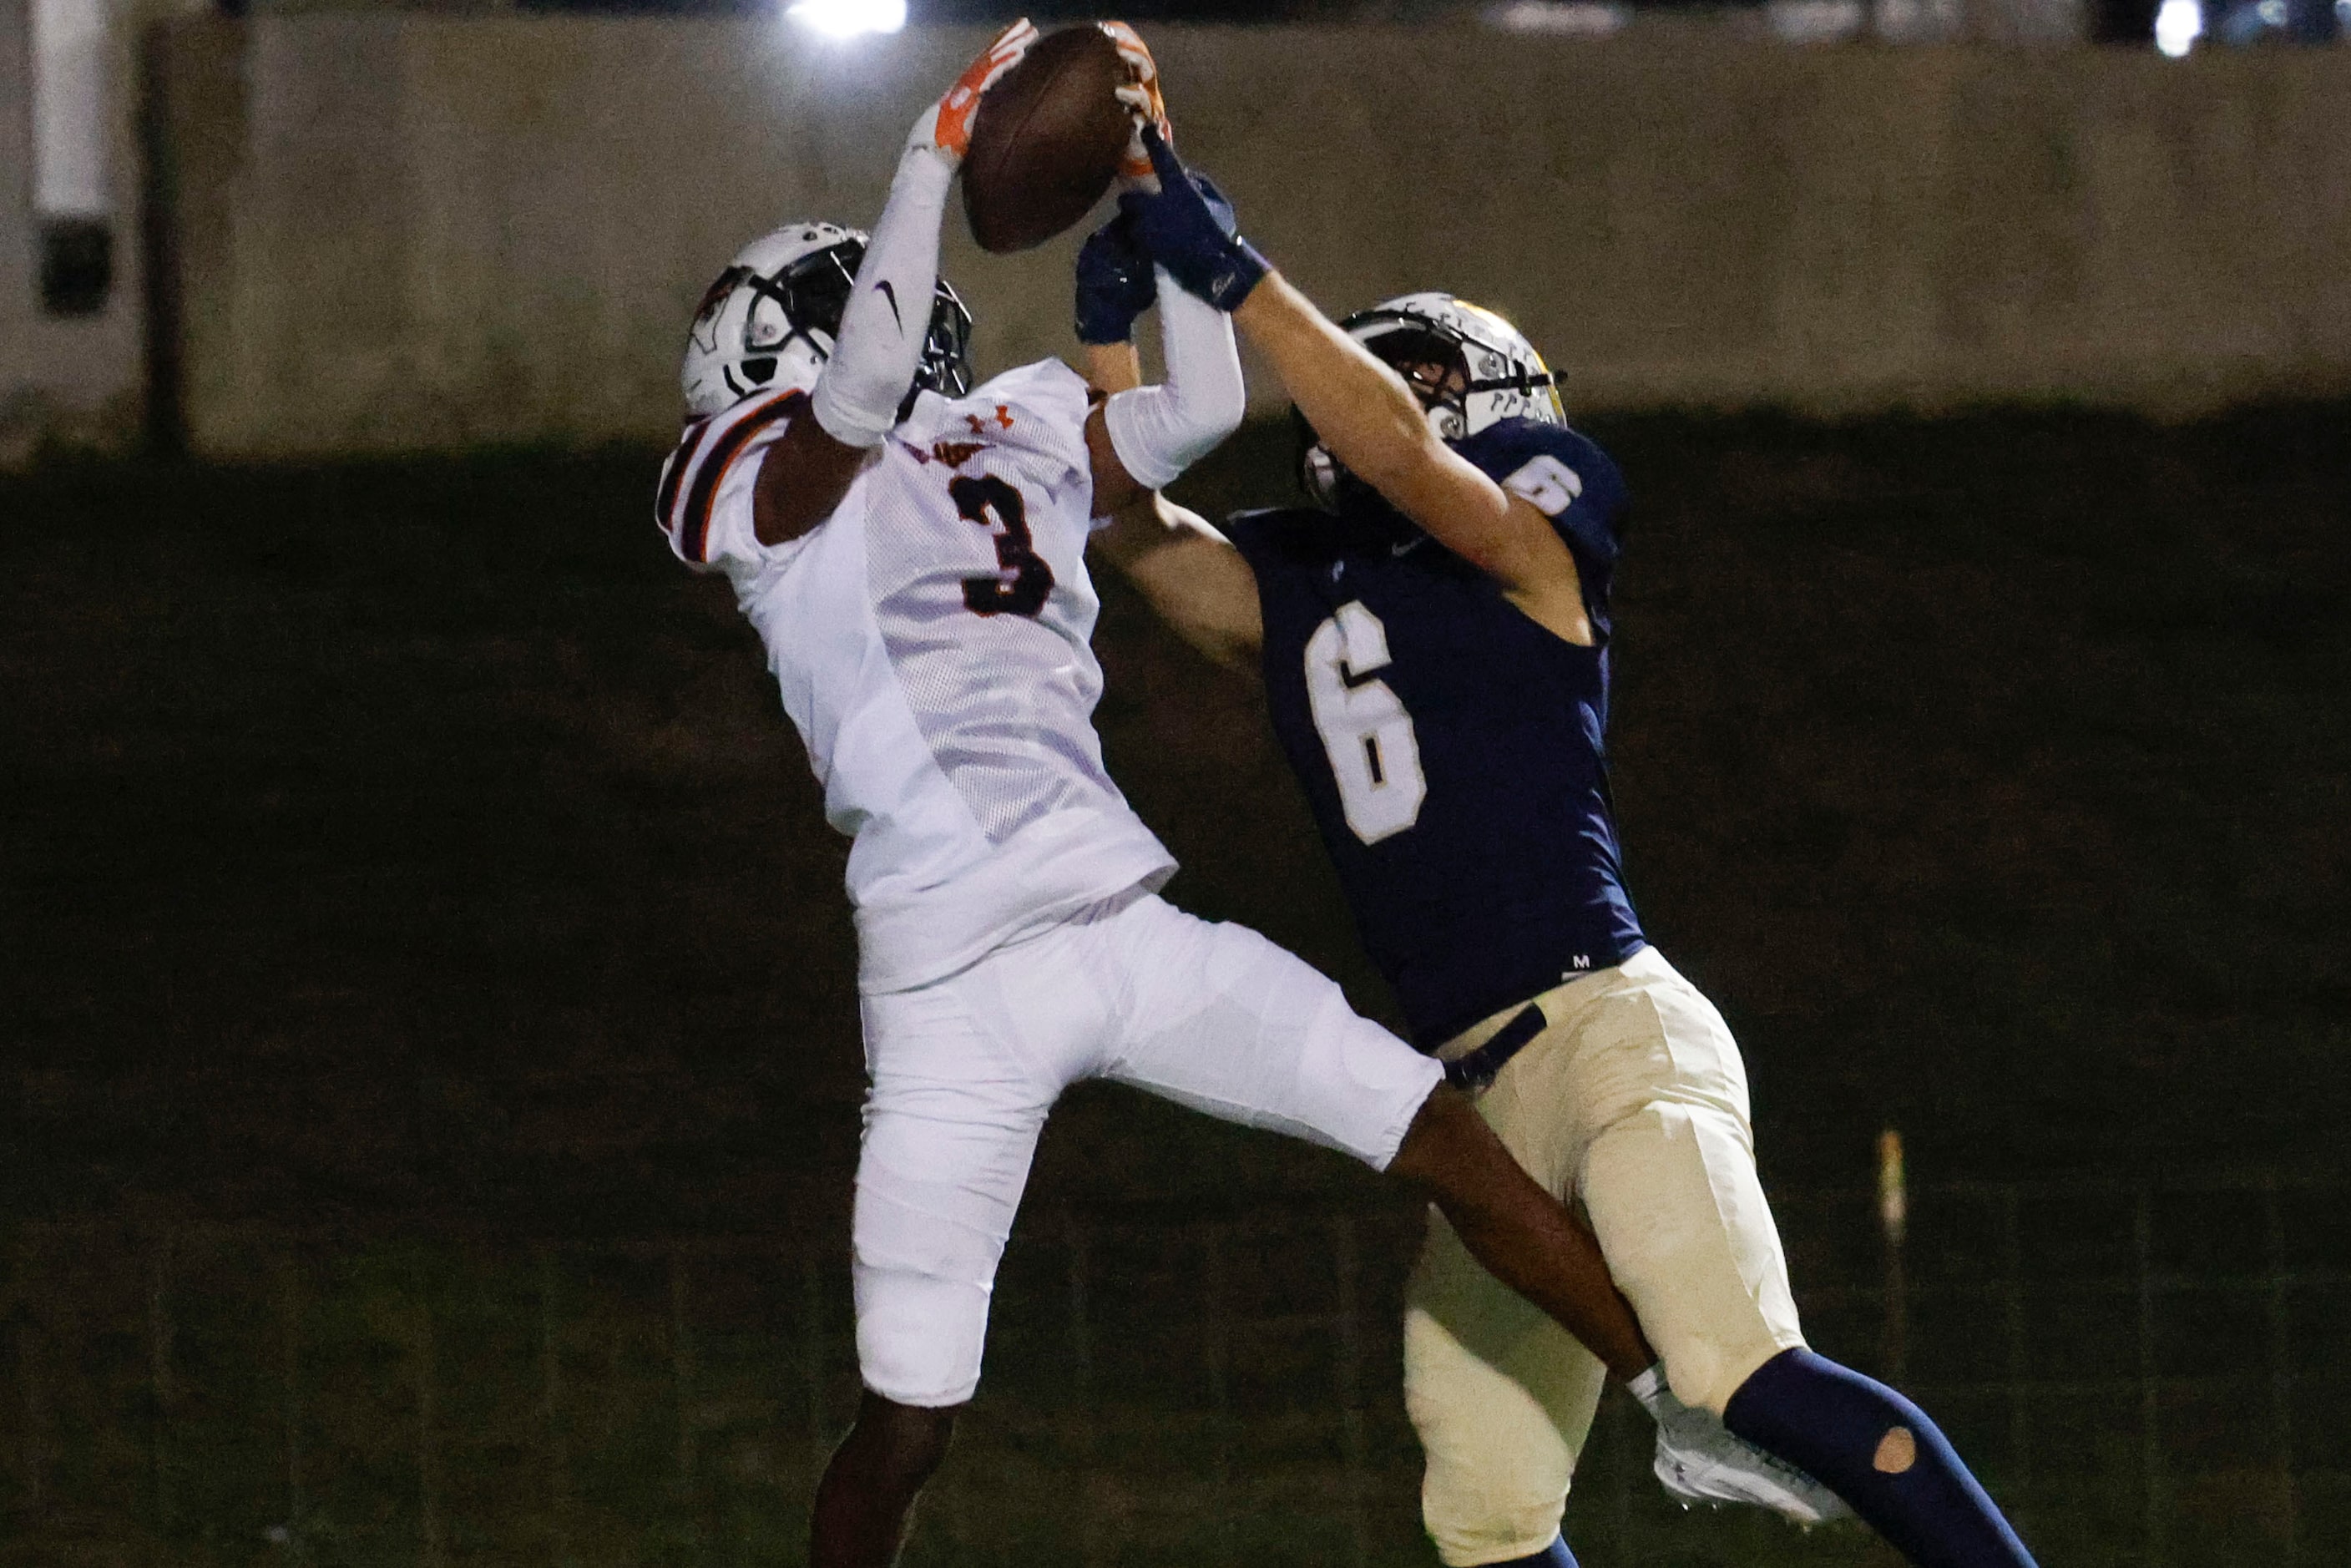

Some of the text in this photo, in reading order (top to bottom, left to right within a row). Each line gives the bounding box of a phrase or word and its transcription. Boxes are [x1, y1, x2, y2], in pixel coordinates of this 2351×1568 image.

[949, 473, 1054, 618] 3
[1304, 599, 1428, 847] 6
[1573, 954, 1590, 969] M
